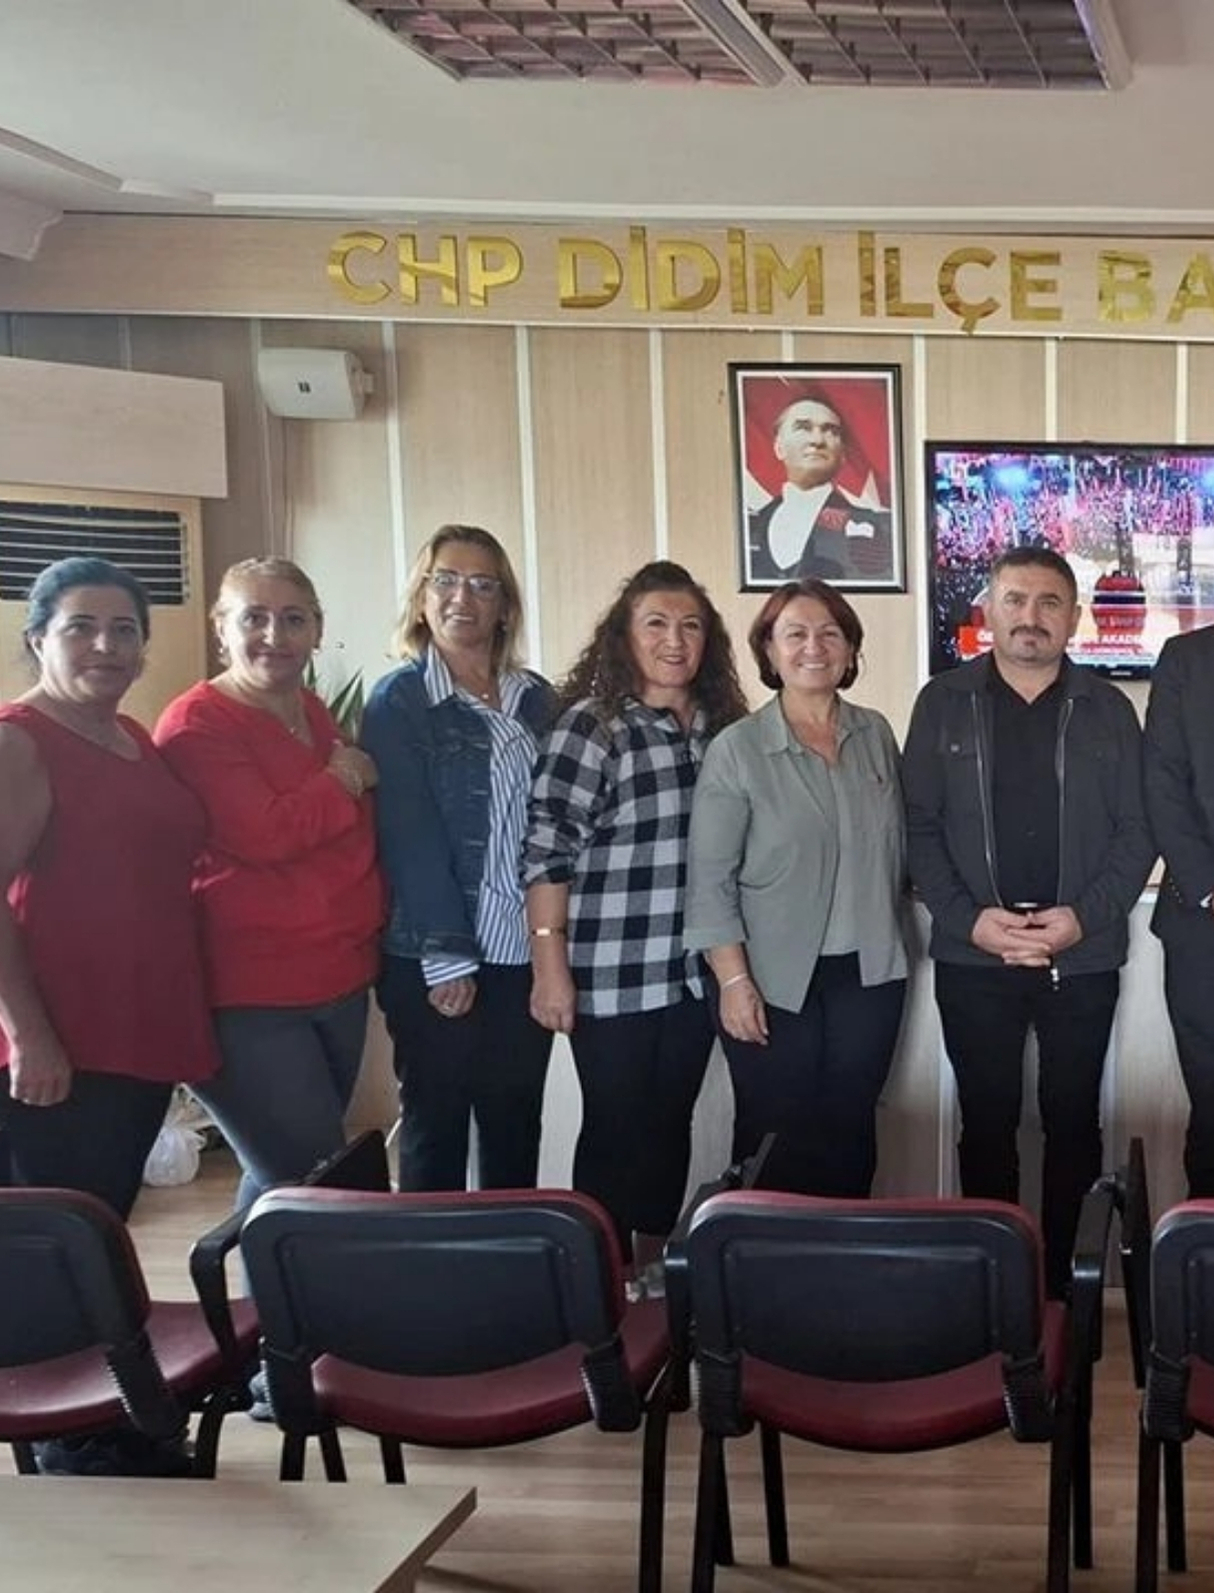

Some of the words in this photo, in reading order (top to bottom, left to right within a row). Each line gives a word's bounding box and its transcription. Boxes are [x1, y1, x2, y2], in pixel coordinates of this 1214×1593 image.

[327, 230, 524, 308] CHP
[557, 225, 824, 317] DİDİM
[857, 230, 1062, 335] İLÇE
